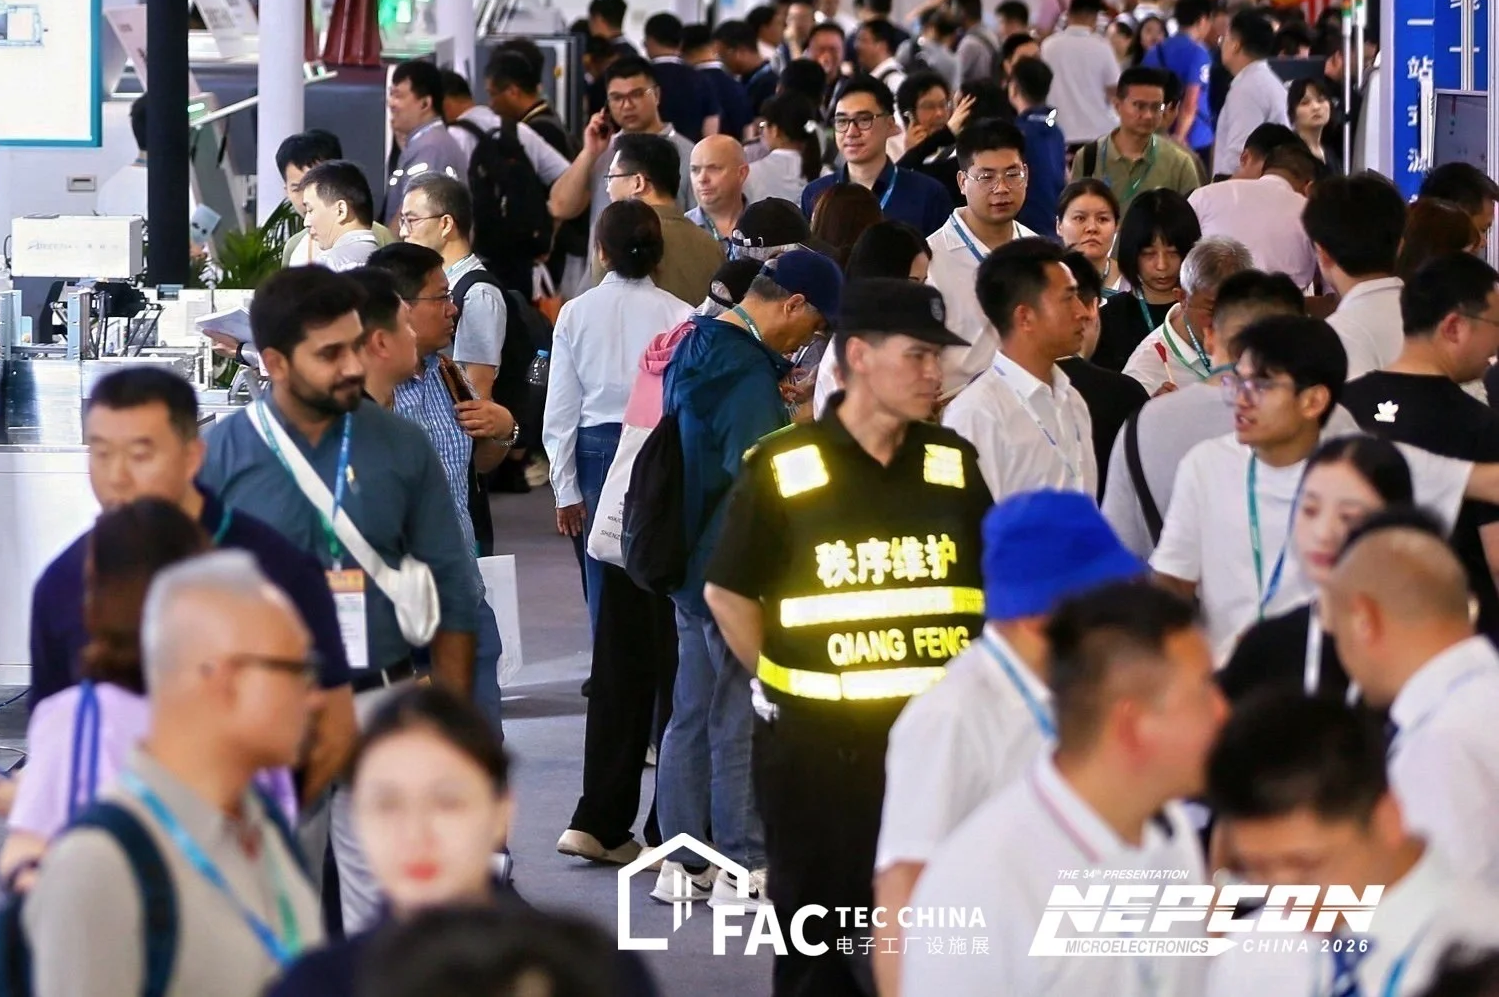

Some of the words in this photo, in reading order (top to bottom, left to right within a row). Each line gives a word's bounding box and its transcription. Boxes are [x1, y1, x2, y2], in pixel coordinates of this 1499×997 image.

[600, 529, 621, 540] SHENZ
[815, 533, 957, 588] 秩序维护
[828, 628, 907, 666] QIANG
[913, 626, 971, 660] FENG
